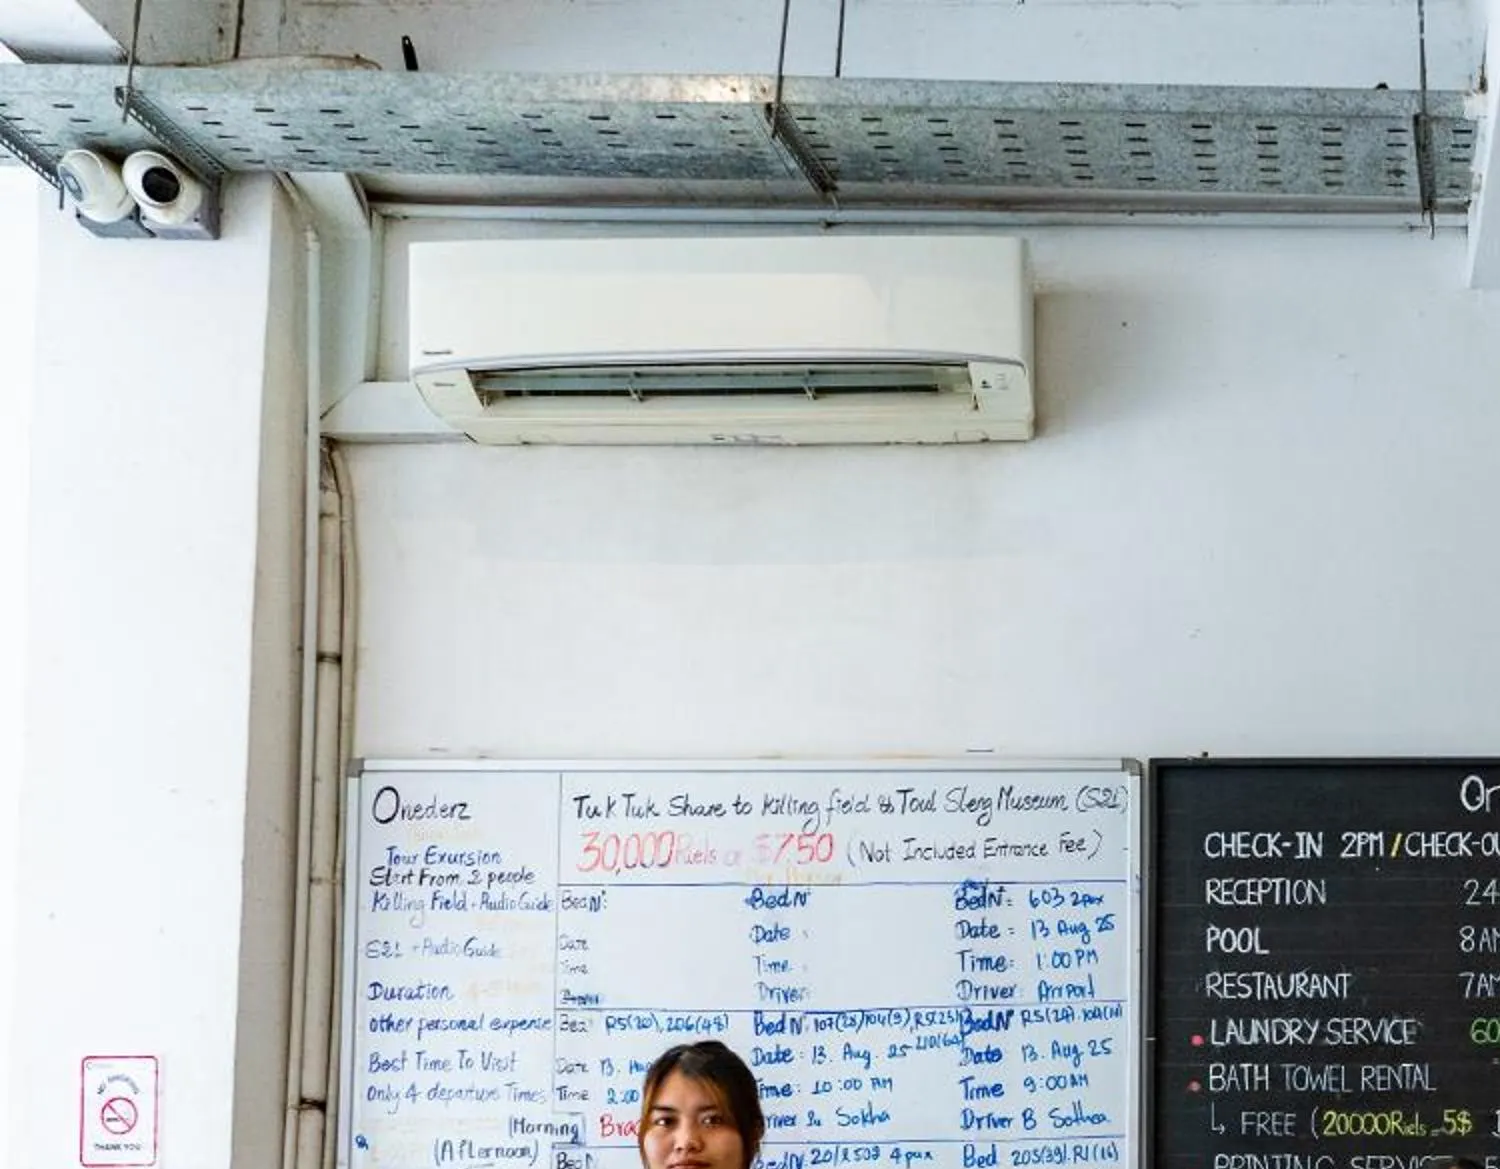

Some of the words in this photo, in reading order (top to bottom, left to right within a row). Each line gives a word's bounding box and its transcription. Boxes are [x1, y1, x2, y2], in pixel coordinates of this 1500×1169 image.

[372, 786, 472, 824] Onederz
[669, 793, 727, 817] Share
[736, 794, 753, 816] to
[996, 785, 1068, 813] Museum
[903, 837, 976, 861] Included
[983, 836, 1049, 859] Entrance
[1204, 831, 1324, 858] CHECK-IN
[419, 867, 460, 887] From
[1205, 877, 1327, 905] RECEPTION
[955, 917, 1001, 940] Date
[1205, 924, 1271, 955] POOL
[367, 981, 454, 1002] Duration
[1205, 970, 1352, 1000] RESTAURANT
[1211, 1018, 1320, 1047] LAUNDRY
[1325, 1018, 1418, 1045] SERVICE
[415, 1050, 454, 1072] Time
[456, 1049, 475, 1071] To
[959, 1076, 1005, 1101] Time
[1209, 1062, 1270, 1092] BATH
[1281, 1064, 1353, 1092] TOWEL
[1361, 1063, 1437, 1092] RENTAL
[960, 1107, 1015, 1130] Driver
[1240, 1111, 1297, 1137] FREE
